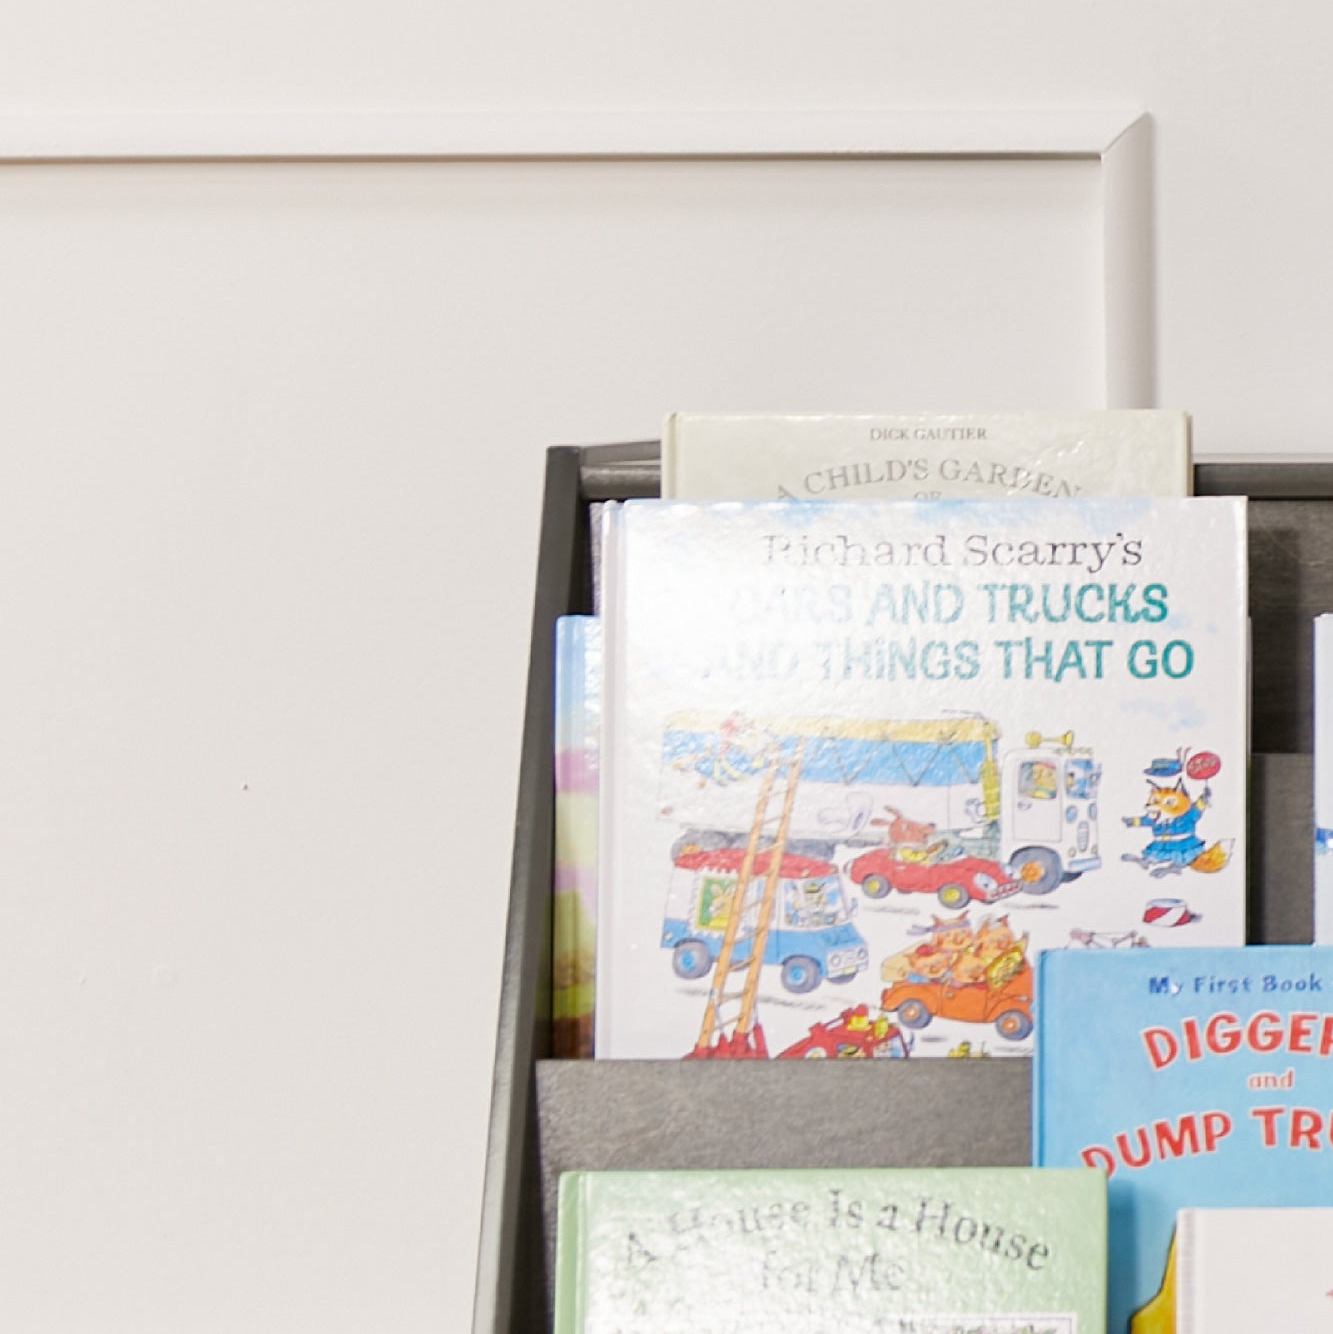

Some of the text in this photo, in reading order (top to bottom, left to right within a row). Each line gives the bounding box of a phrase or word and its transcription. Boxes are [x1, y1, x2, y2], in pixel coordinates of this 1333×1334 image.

[870, 427, 987, 441] DICK GAUTIER
[804, 459, 928, 495] CHILD'S
[939, 459, 1083, 499] GARDEN
[763, 533, 1142, 573] Richard Scarry's
[869, 581, 963, 626] AND
[978, 582, 1168, 624] TRUCKS
[995, 637, 1113, 682] THAT
[1127, 640, 1195, 679] GO
[1149, 975, 1183, 997] My
[1193, 974, 1251, 994] First
[1262, 973, 1322, 994] Book
[1247, 1068, 1295, 1090] and
[1081, 1109, 1232, 1179] DUMP
[876, 1200, 900, 1231] a
[914, 1196, 1050, 1271] House
